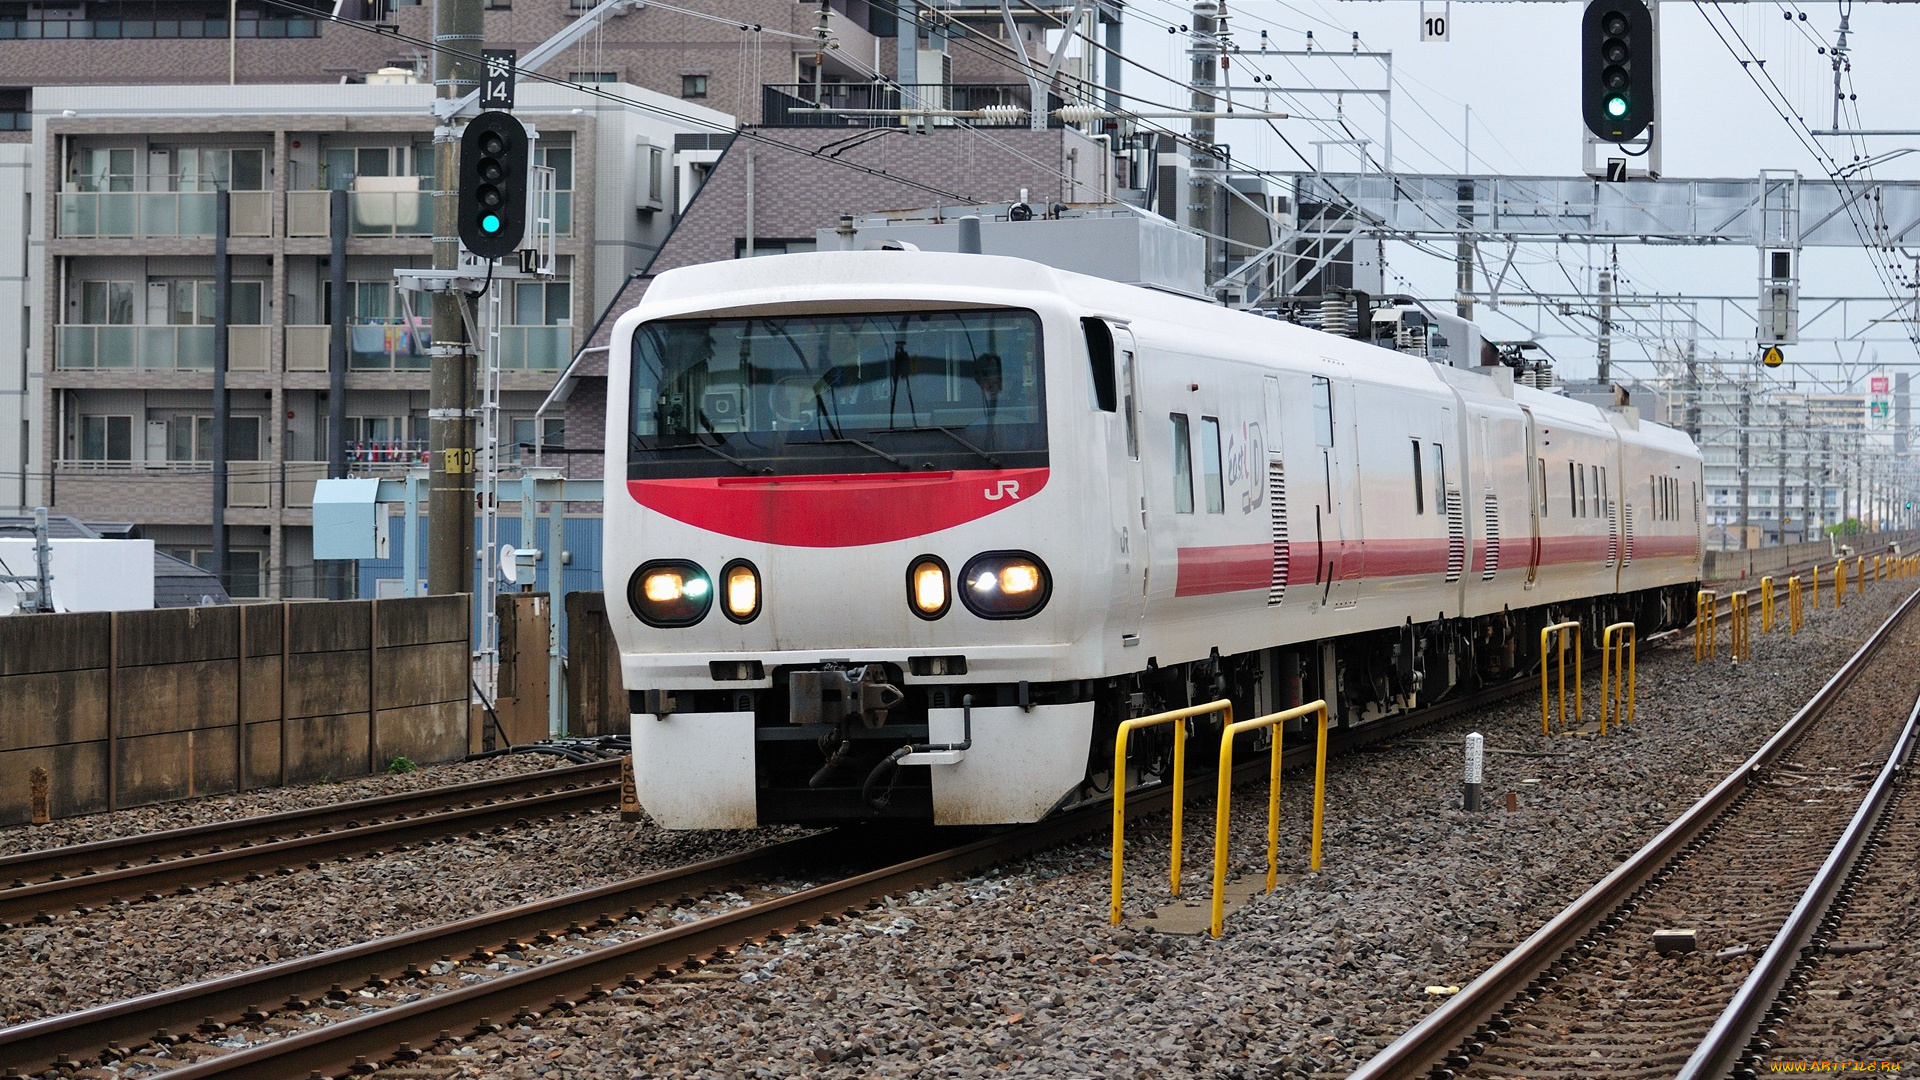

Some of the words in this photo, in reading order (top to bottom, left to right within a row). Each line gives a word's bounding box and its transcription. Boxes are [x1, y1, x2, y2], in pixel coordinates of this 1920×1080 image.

[1425, 17, 1445, 36] 10
[487, 57, 509, 77] 快
[487, 81, 507, 101] 14
[1609, 159, 1625, 182] 7
[520, 250, 536, 272] 14
[1769, 353, 1777, 362] 6
[984, 480, 1020, 500] JR
[1119, 526, 1129, 554] JR
